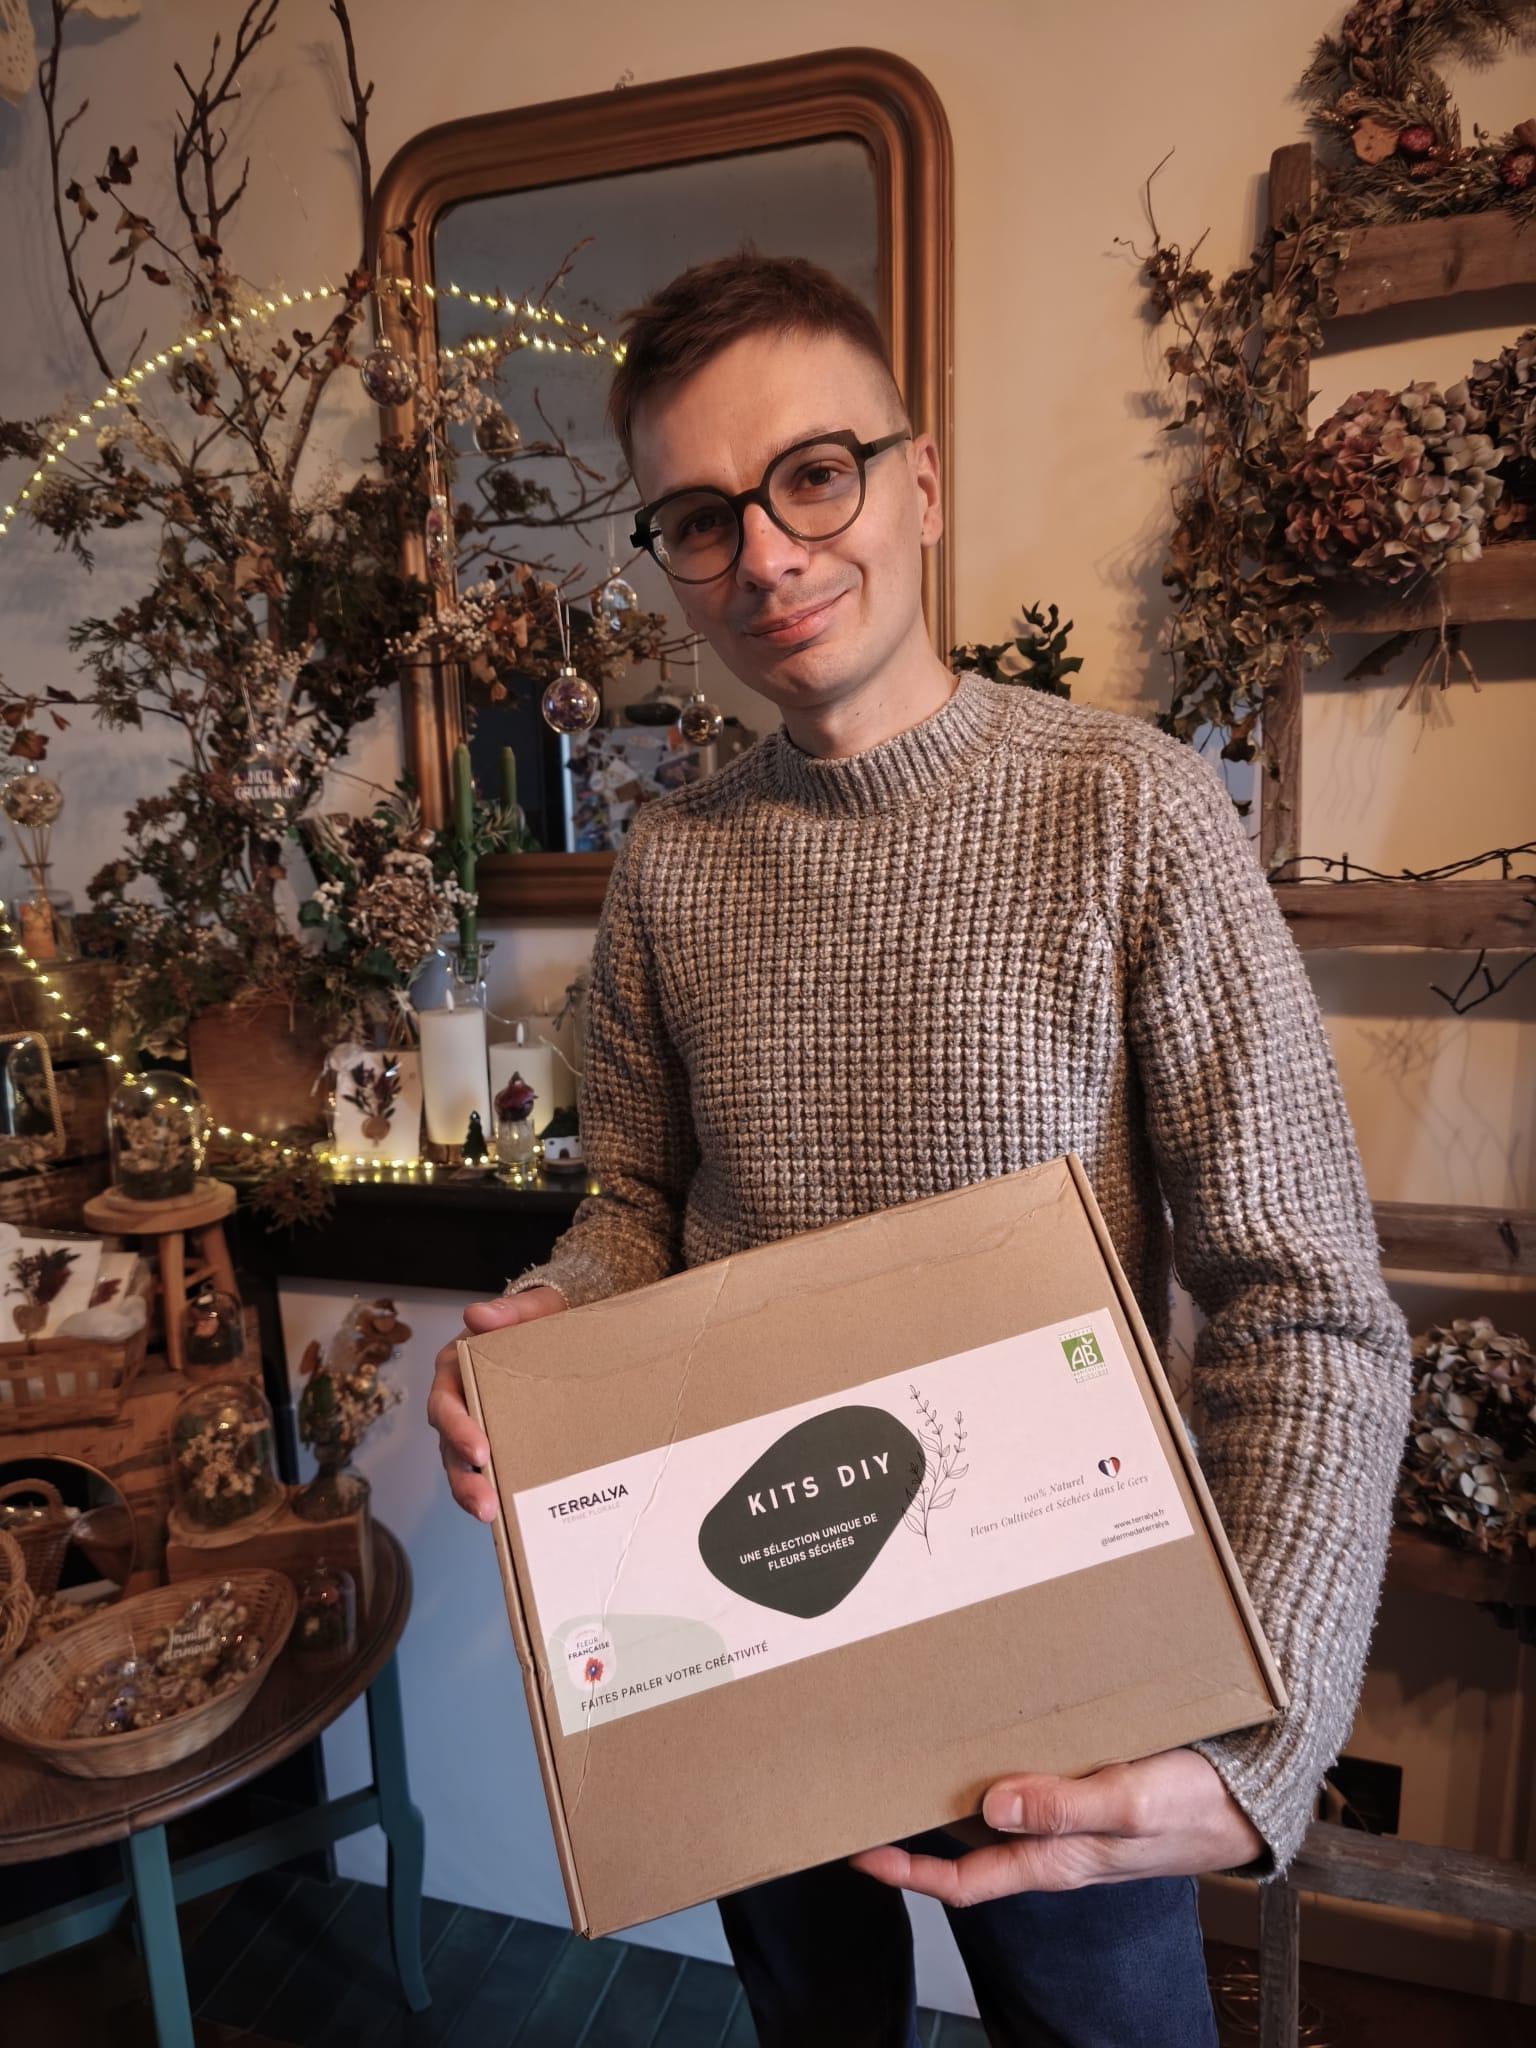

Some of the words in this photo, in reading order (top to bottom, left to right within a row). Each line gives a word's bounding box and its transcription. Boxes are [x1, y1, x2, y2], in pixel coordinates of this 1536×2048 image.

[1072, 1344, 1098, 1370] AB
[548, 1484, 629, 1519] TERRALYA
[748, 1476, 819, 1516] KITS
[837, 1452, 889, 1488] DIY
[1024, 1489, 1047, 1503] 100%
[1050, 1475, 1085, 1494] Naturel
[970, 1522, 999, 1536] Fleurs
[1001, 1507, 1044, 1527] Cultivées
[1045, 1503, 1054, 1513] et
[1056, 1490, 1091, 1509] Séchées
[1093, 1484, 1116, 1499] dans
[1116, 1480, 1126, 1491] le
[1128, 1475, 1149, 1488] Gers
[739, 1550, 762, 1565] UNE
[763, 1531, 821, 1557] SÉLECTION
[822, 1518, 862, 1537] UNIQUE
[863, 1512, 879, 1525] DE
[768, 1551, 807, 1571] FLEURS
[809, 1536, 855, 1558] SÉCHÉES
[576, 1636, 598, 1649] FLEUR
[581, 1691, 619, 1711] FAITES
[621, 1676, 663, 1698] PARLER
[665, 1663, 703, 1683] VOTRE
[705, 1640, 769, 1670] CRÉATIVITÉ
